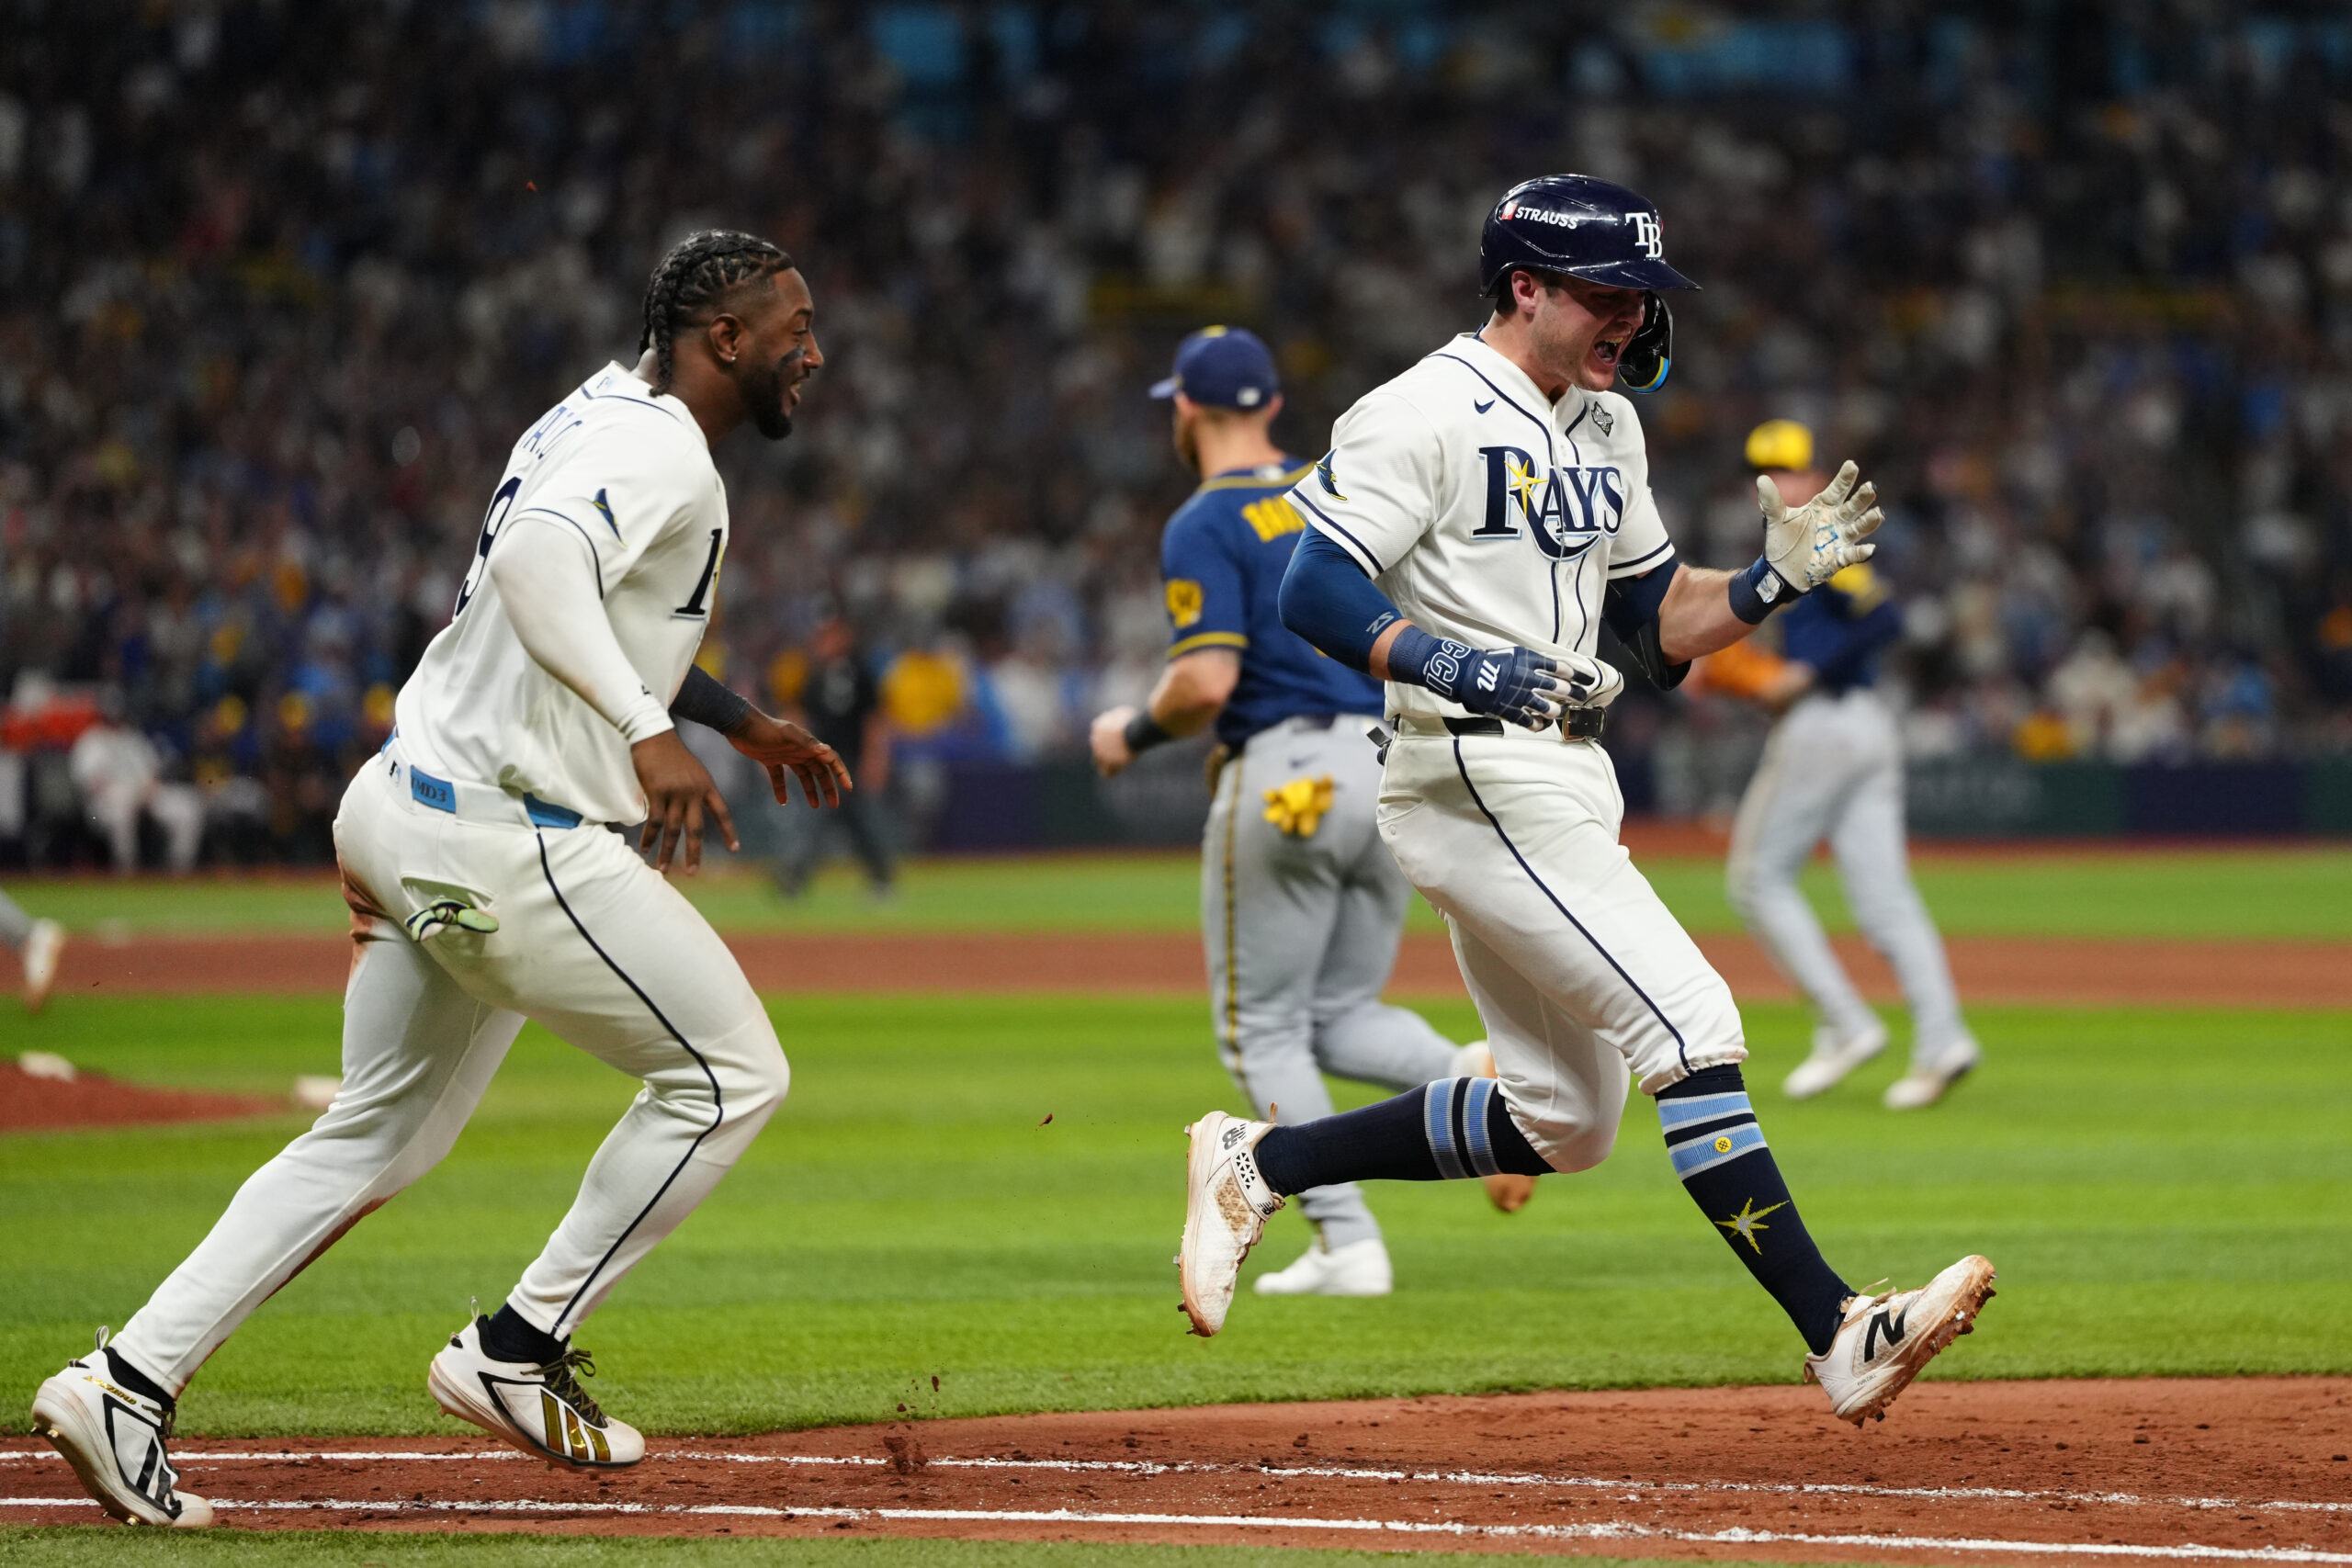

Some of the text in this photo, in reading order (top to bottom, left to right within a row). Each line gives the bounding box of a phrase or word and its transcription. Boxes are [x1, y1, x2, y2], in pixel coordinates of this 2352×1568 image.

[1515, 206, 1578, 230] STRAUSS
[1625, 212, 1663, 258] TB
[1471, 445, 1625, 562] RAYS
